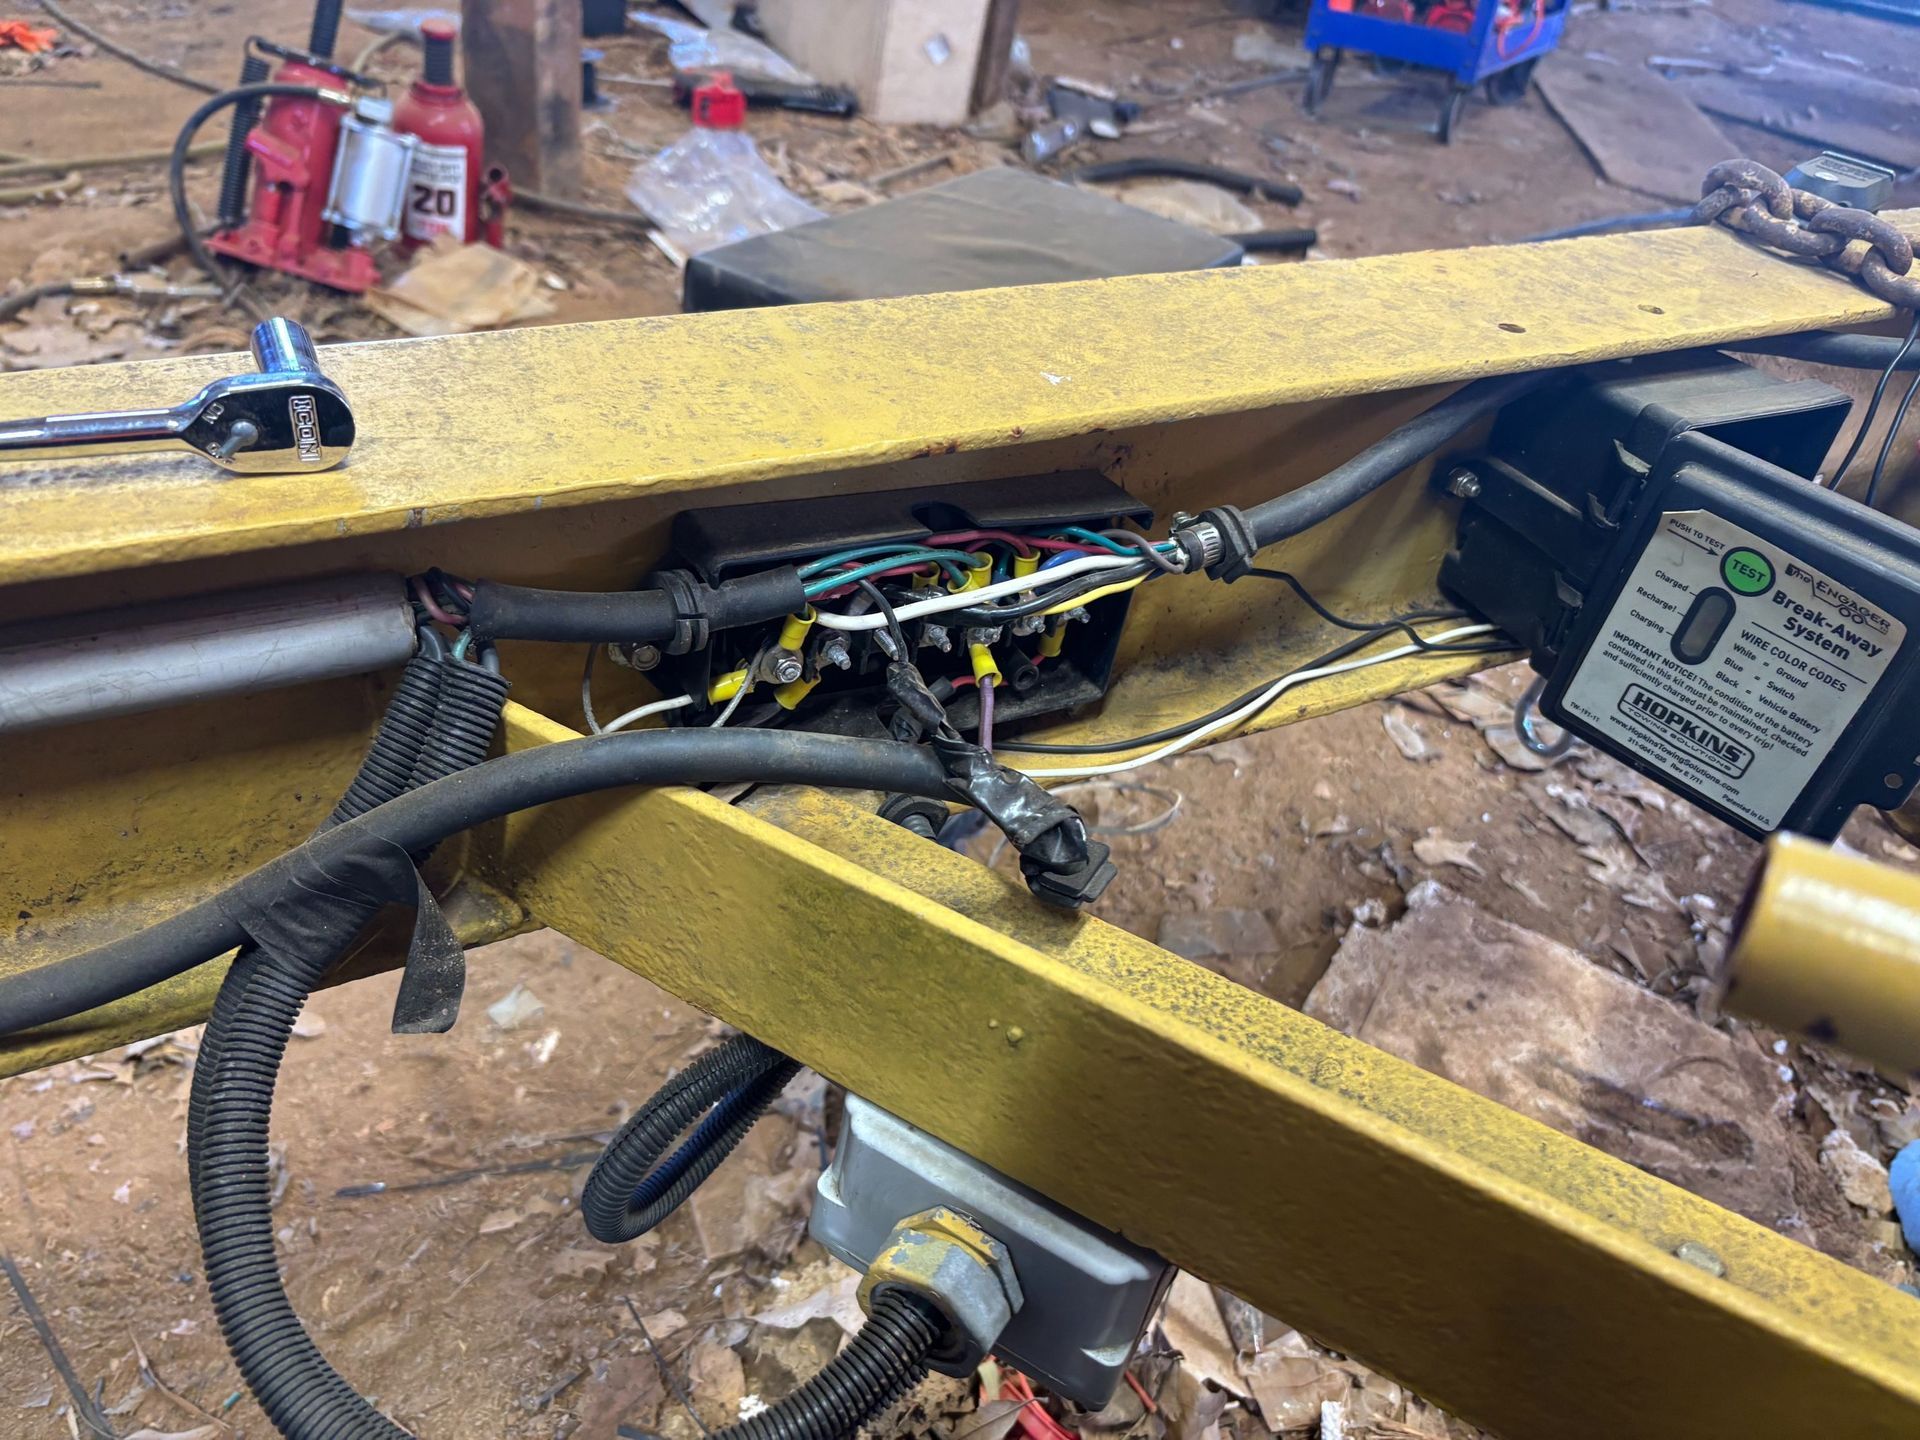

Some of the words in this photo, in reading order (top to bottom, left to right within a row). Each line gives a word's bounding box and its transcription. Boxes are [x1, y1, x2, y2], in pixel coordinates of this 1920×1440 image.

[413, 184, 455, 217] 20
[201, 401, 225, 425] ON
[292, 398, 321, 461] ICON
[1669, 519, 1692, 533] PUSH
[1693, 531, 1703, 539] TO
[1704, 536, 1726, 550] TEST
[1655, 570, 1689, 592] Charged
[1732, 559, 1766, 583] TEST
[1630, 609, 1664, 633] Charging
[1637, 586, 1677, 612] Recharge!
[1816, 581, 1890, 630] ENGAGER
[1773, 590, 1882, 657] Break-Away
[1784, 616, 1850, 660] System
[1724, 657, 1744, 672] Blue
[1766, 680, 1795, 700] Switch
[1733, 643, 1756, 660] White
[1776, 667, 1808, 688] Ground
[1740, 630, 1770, 651] WIRE
[1770, 646, 1808, 672] COLOR
[1808, 667, 1847, 692] CODES
[1603, 650, 1618, 662] and
[1619, 658, 1663, 688] sufficiently
[1662, 683, 1697, 706] charged
[1696, 704, 1720, 719] prior
[1720, 715, 1728, 724] to
[1729, 722, 1754, 740] every
[1754, 736, 1774, 750] trip!
[1608, 640, 1647, 666] contained
[1647, 662, 1656, 670] in
[1656, 667, 1672, 680] this
[1672, 676, 1685, 688] kit
[1685, 684, 1706, 700] must
[1707, 695, 1718, 706] be
[1720, 702, 1768, 736] maintained,
[1770, 733, 1809, 757] checked
[1613, 630, 1662, 661] IMPORTANT
[1661, 658, 1698, 682] NOTICE!
[1698, 677, 1714, 691] The
[1714, 689, 1753, 714] condition
[1754, 712, 1765, 720] of
[1765, 716, 1780, 728] the
[1780, 725, 1814, 748] battery
[1715, 671, 1739, 688] Black
[1759, 694, 1788, 716] Vehicle
[1788, 712, 1821, 734] Battery
[1628, 707, 1668, 733] TOWING
[1670, 732, 1732, 771] SOLUTIONS
[1632, 691, 1743, 763] HOPKINS
[1609, 715, 1740, 796] www.HopkinsTowingSolutions.com
[1722, 794, 1751, 814] Patented
